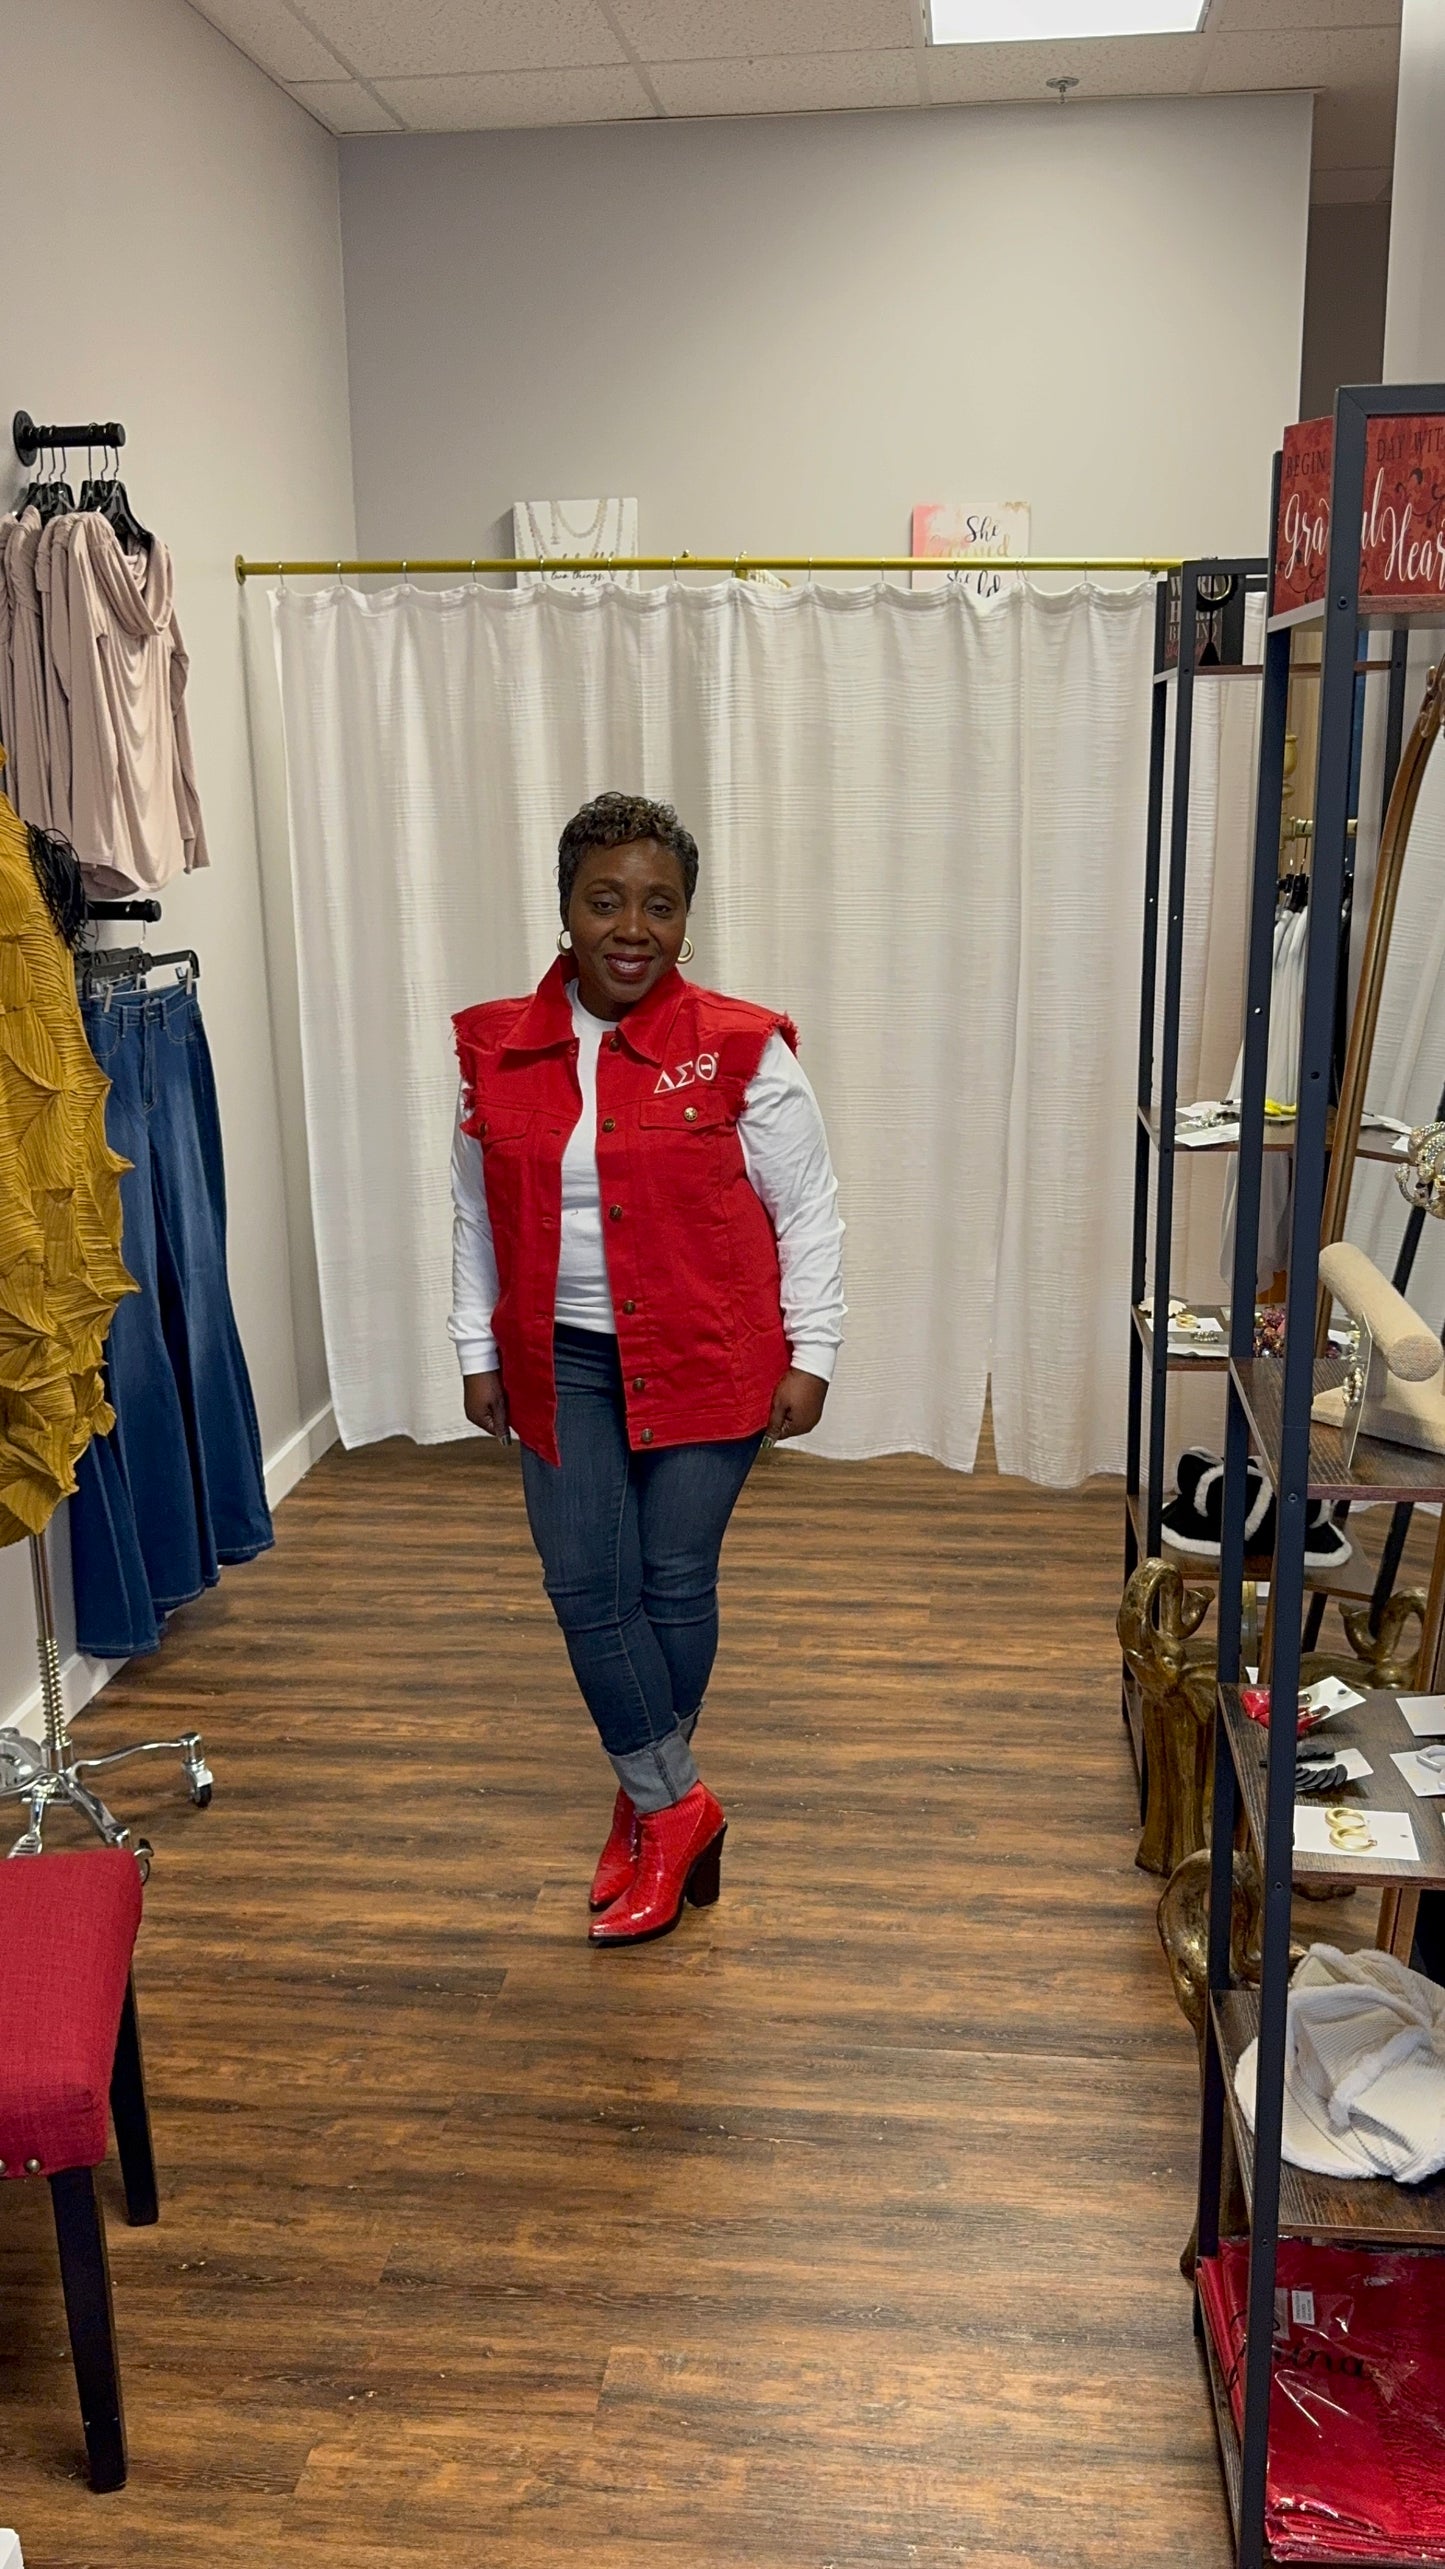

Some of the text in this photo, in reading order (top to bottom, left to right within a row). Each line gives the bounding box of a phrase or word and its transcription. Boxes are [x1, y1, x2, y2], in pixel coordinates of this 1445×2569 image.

[1286, 427, 1445, 478] BEGIN DAY WIT
[964, 515, 998, 543] She
[1381, 503, 1445, 590] Hear
[1170, 576, 1219, 594] WRK
[653, 1053, 719, 1094] ΔΣΘ
